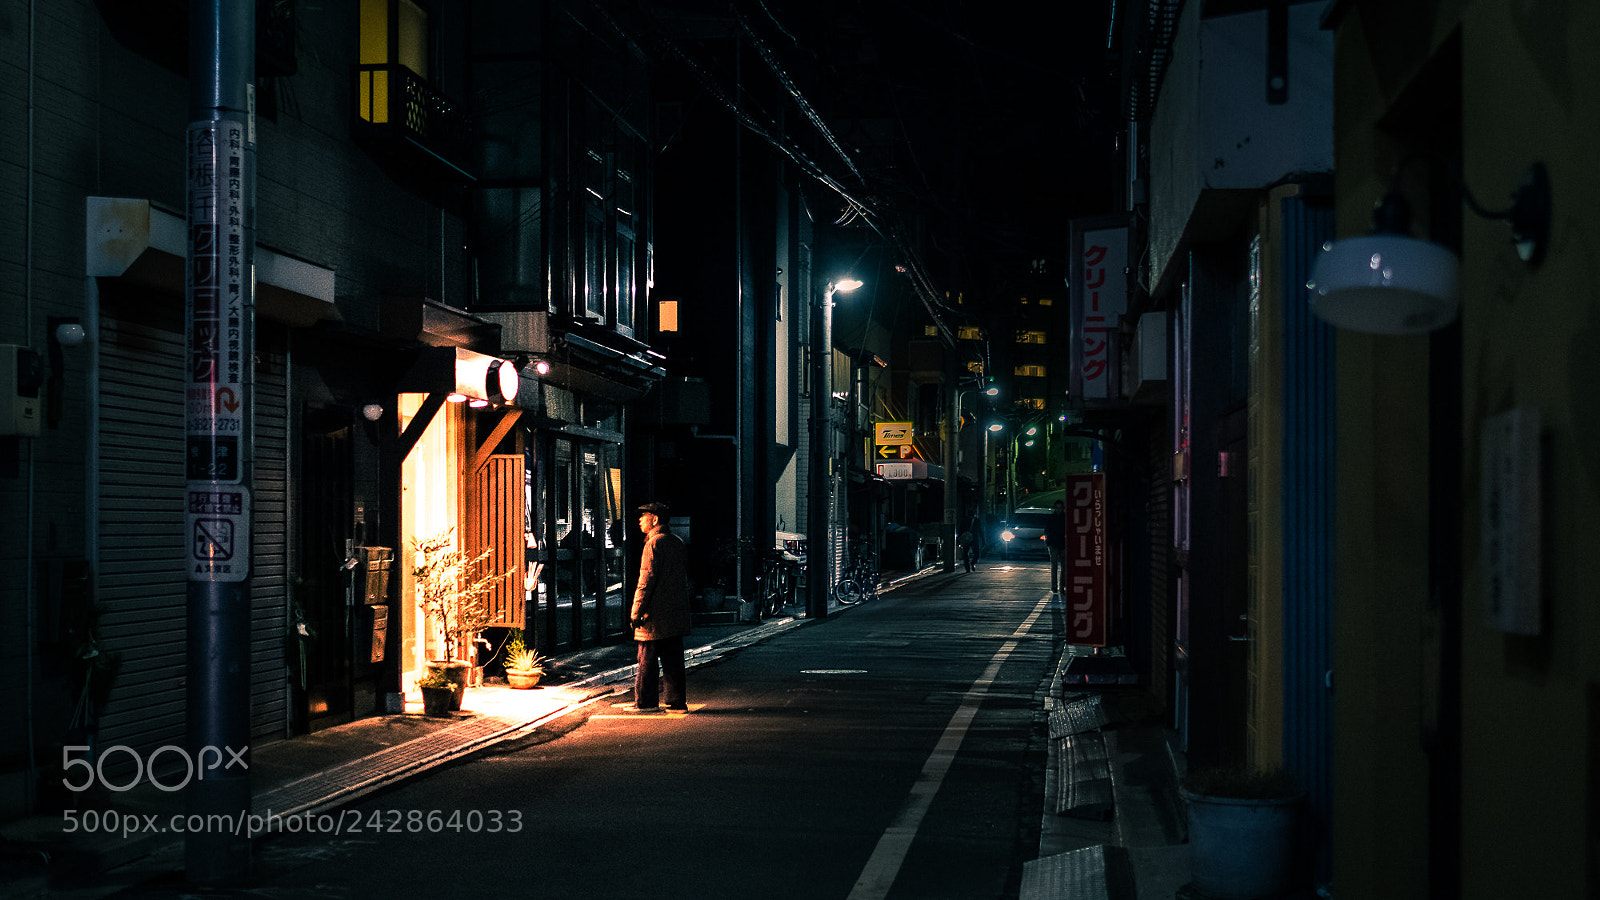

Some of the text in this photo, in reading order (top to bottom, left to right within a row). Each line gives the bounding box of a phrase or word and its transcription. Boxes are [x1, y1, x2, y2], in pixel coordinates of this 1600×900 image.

[1083, 245, 1108, 381] クリーニング
[882, 429, 907, 439] Times
[900, 445, 912, 459] P
[1073, 480, 1094, 639] クリーニング
